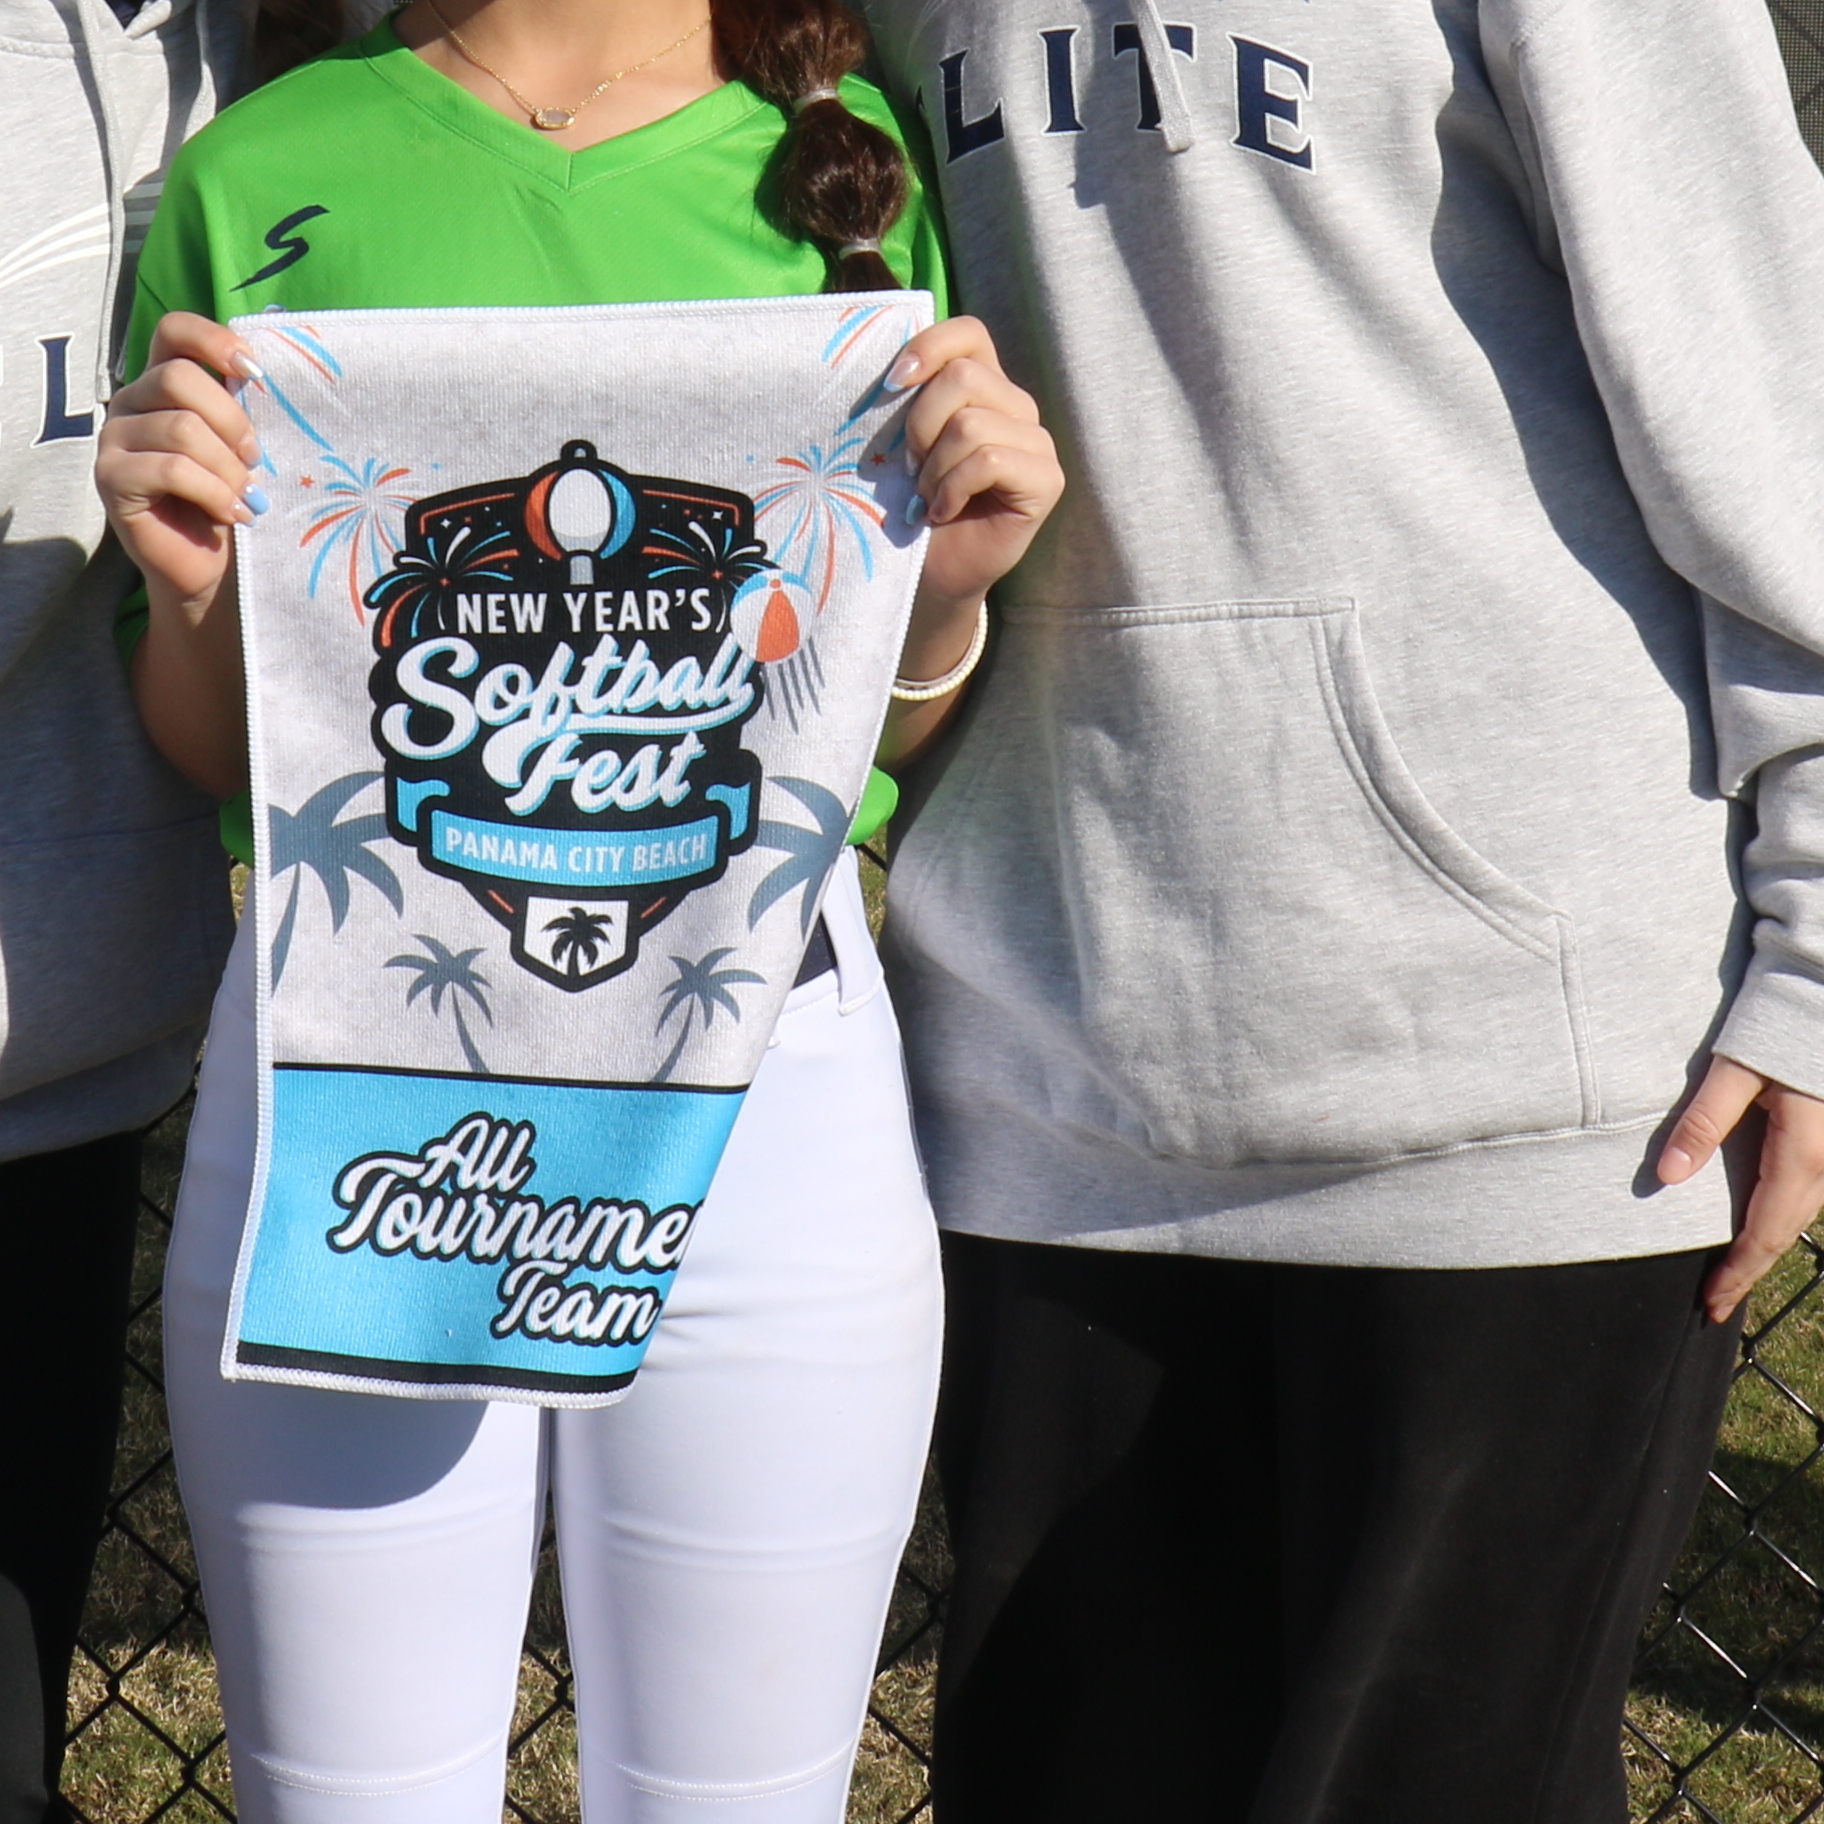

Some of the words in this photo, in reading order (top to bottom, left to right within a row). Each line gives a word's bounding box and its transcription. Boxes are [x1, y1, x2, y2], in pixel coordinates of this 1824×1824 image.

[913, 22, 1317, 175] LITE
[455, 591, 548, 635] NEW
[562, 587, 713, 633] YEAR'S
[380, 632, 756, 761] Softball
[503, 730, 707, 817] Fest
[445, 826, 558, 871] PANAMA
[567, 845, 626, 874] CITY
[631, 832, 709, 873] BEACH
[418, 1116, 533, 1192] All
[495, 1259, 660, 1341] Team
